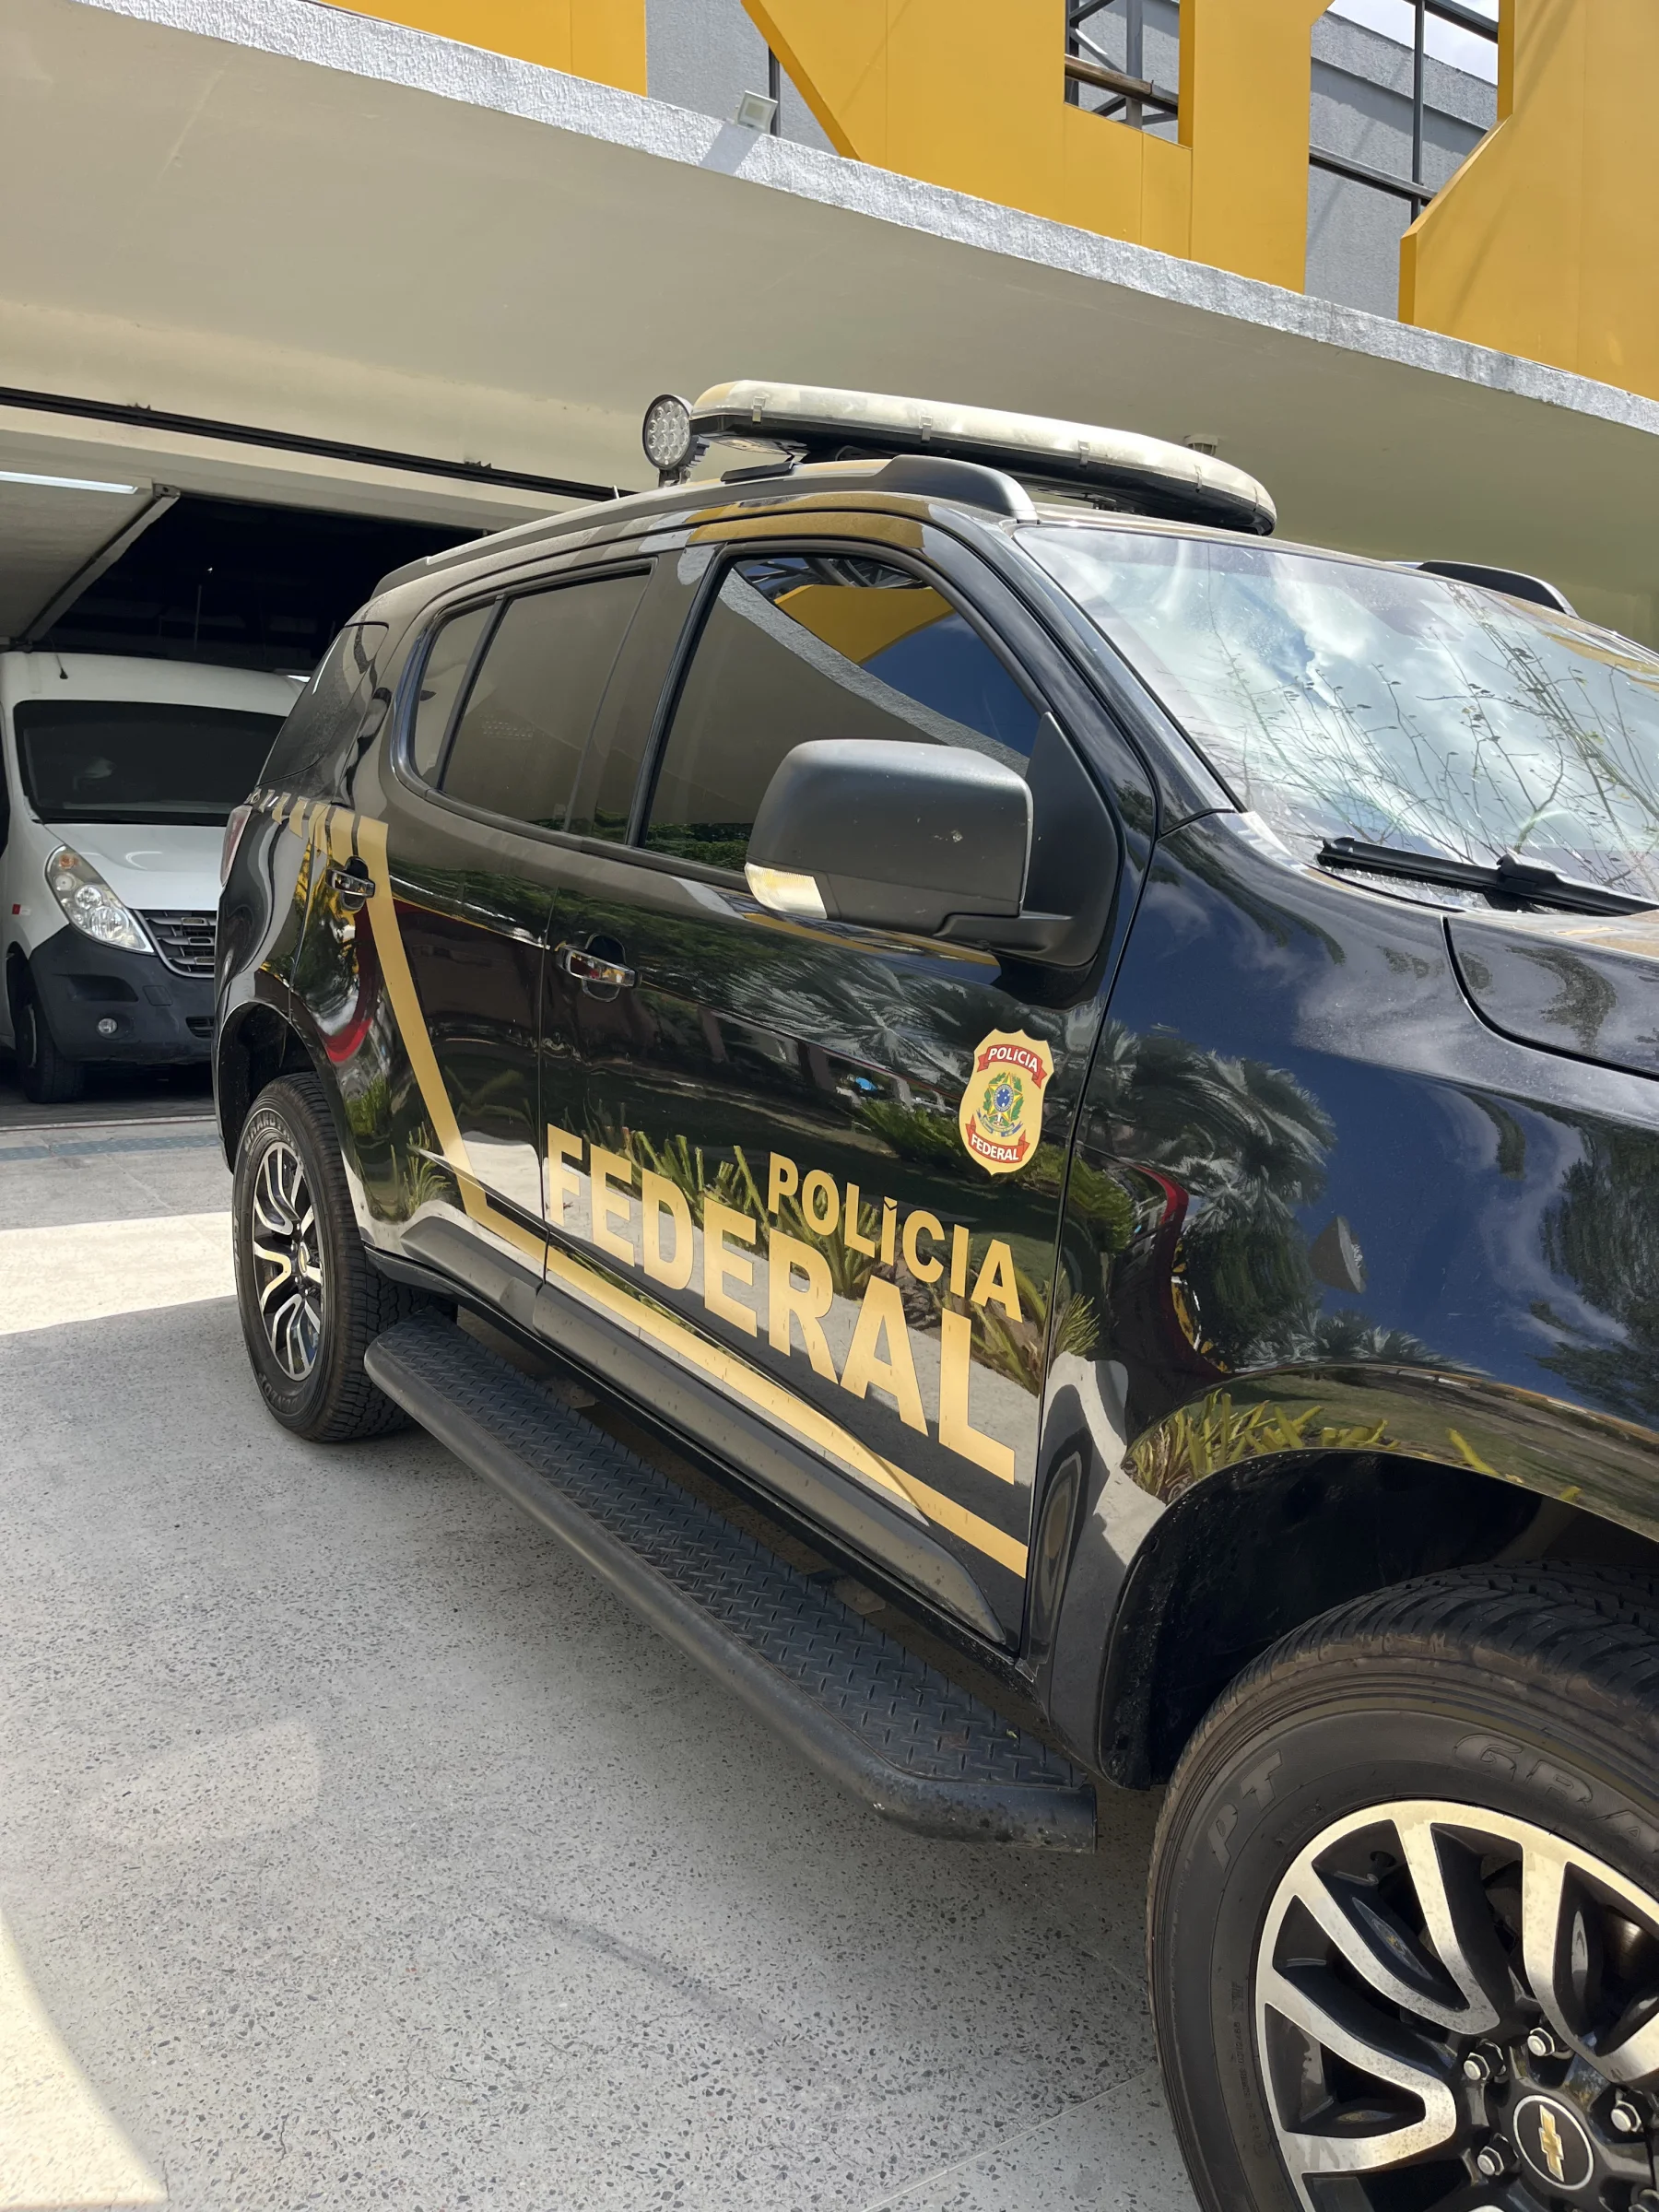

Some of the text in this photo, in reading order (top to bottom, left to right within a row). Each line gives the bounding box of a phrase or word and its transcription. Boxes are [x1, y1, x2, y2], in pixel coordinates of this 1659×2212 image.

[988, 1047, 1038, 1073] POLÍCIA
[971, 1134, 1020, 1160] FEDERAL
[768, 1152, 1023, 1324] POLÍCIA
[547, 1124, 1016, 1485] FEDERAL
